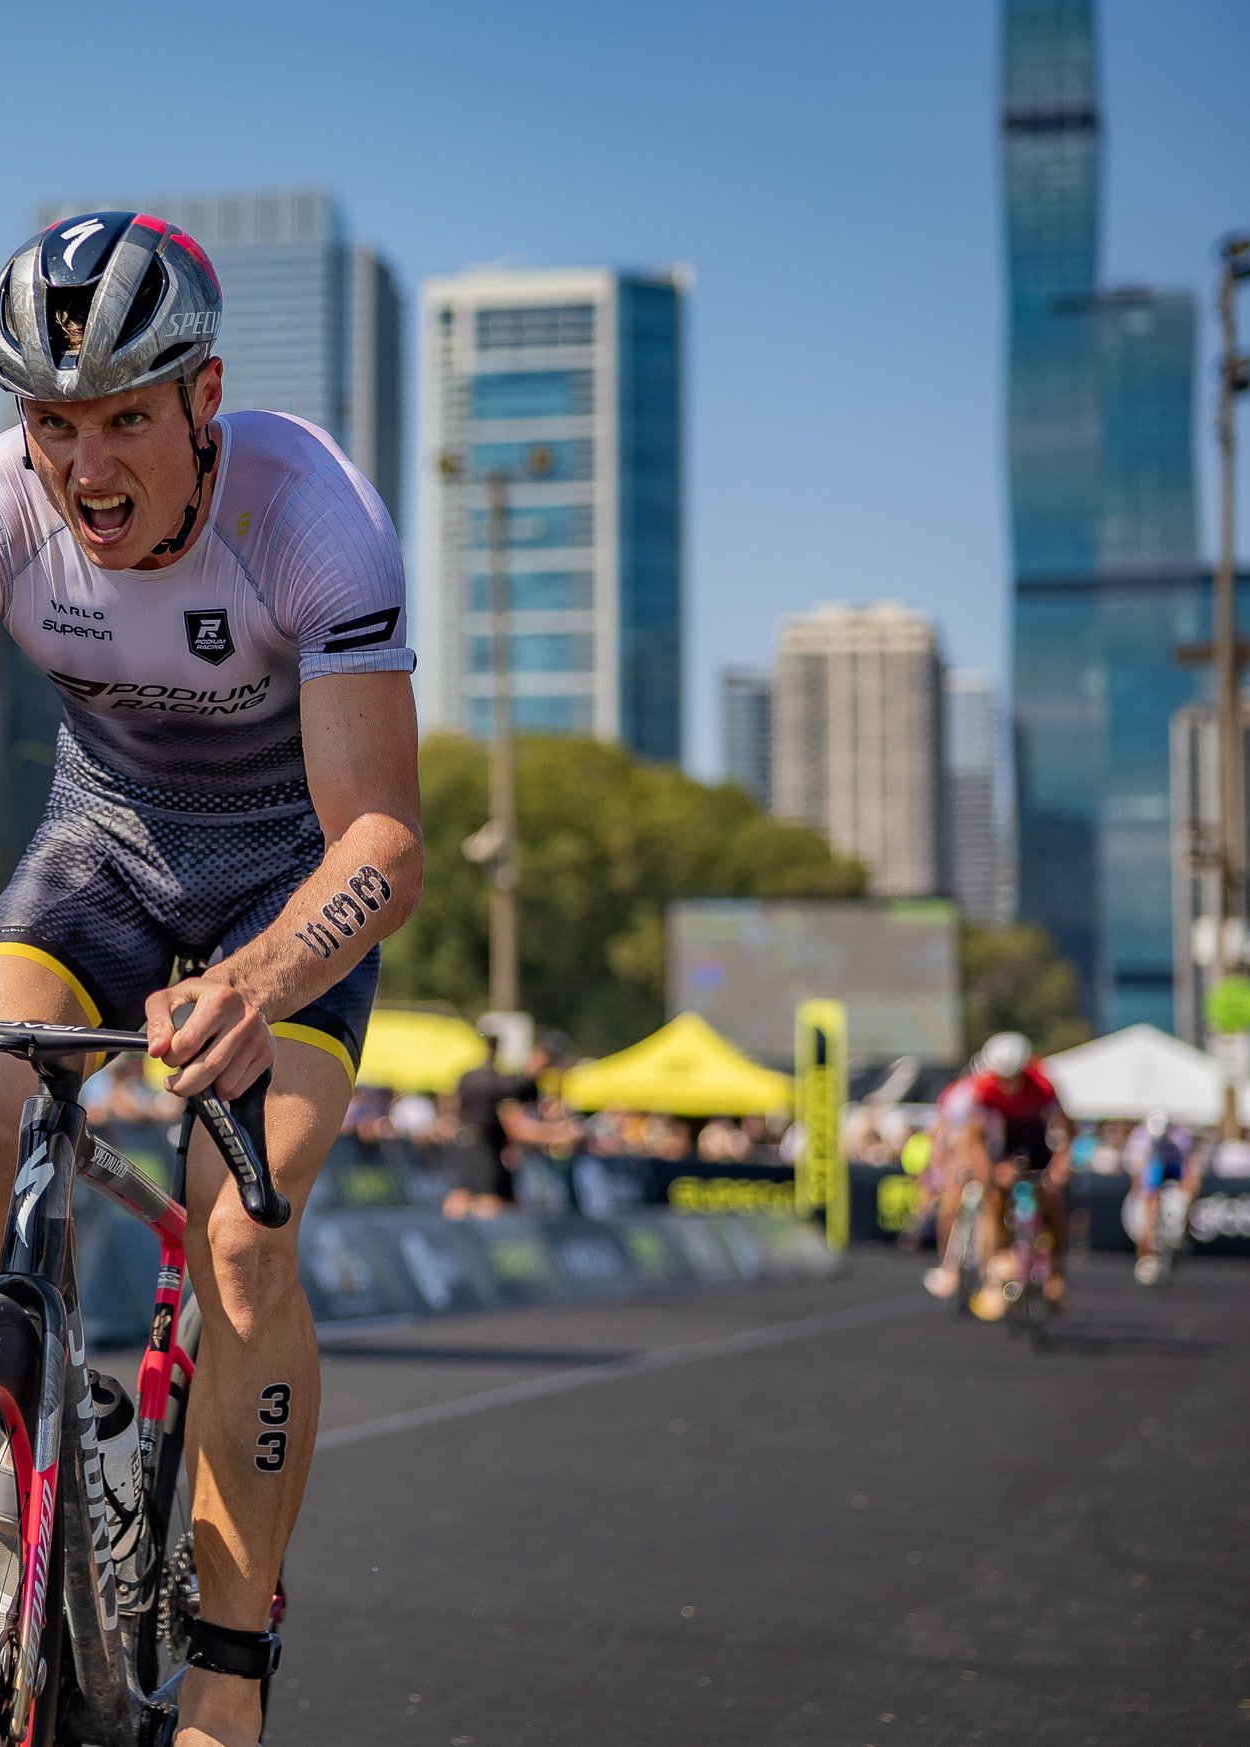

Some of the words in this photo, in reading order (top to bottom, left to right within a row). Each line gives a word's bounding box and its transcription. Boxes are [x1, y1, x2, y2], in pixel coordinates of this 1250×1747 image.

[105, 674, 271, 703] PODIUM
[110, 693, 267, 716] RACING
[203, 1099, 257, 1183] SRAM
[91, 1146, 129, 1178] SPECIALIZED
